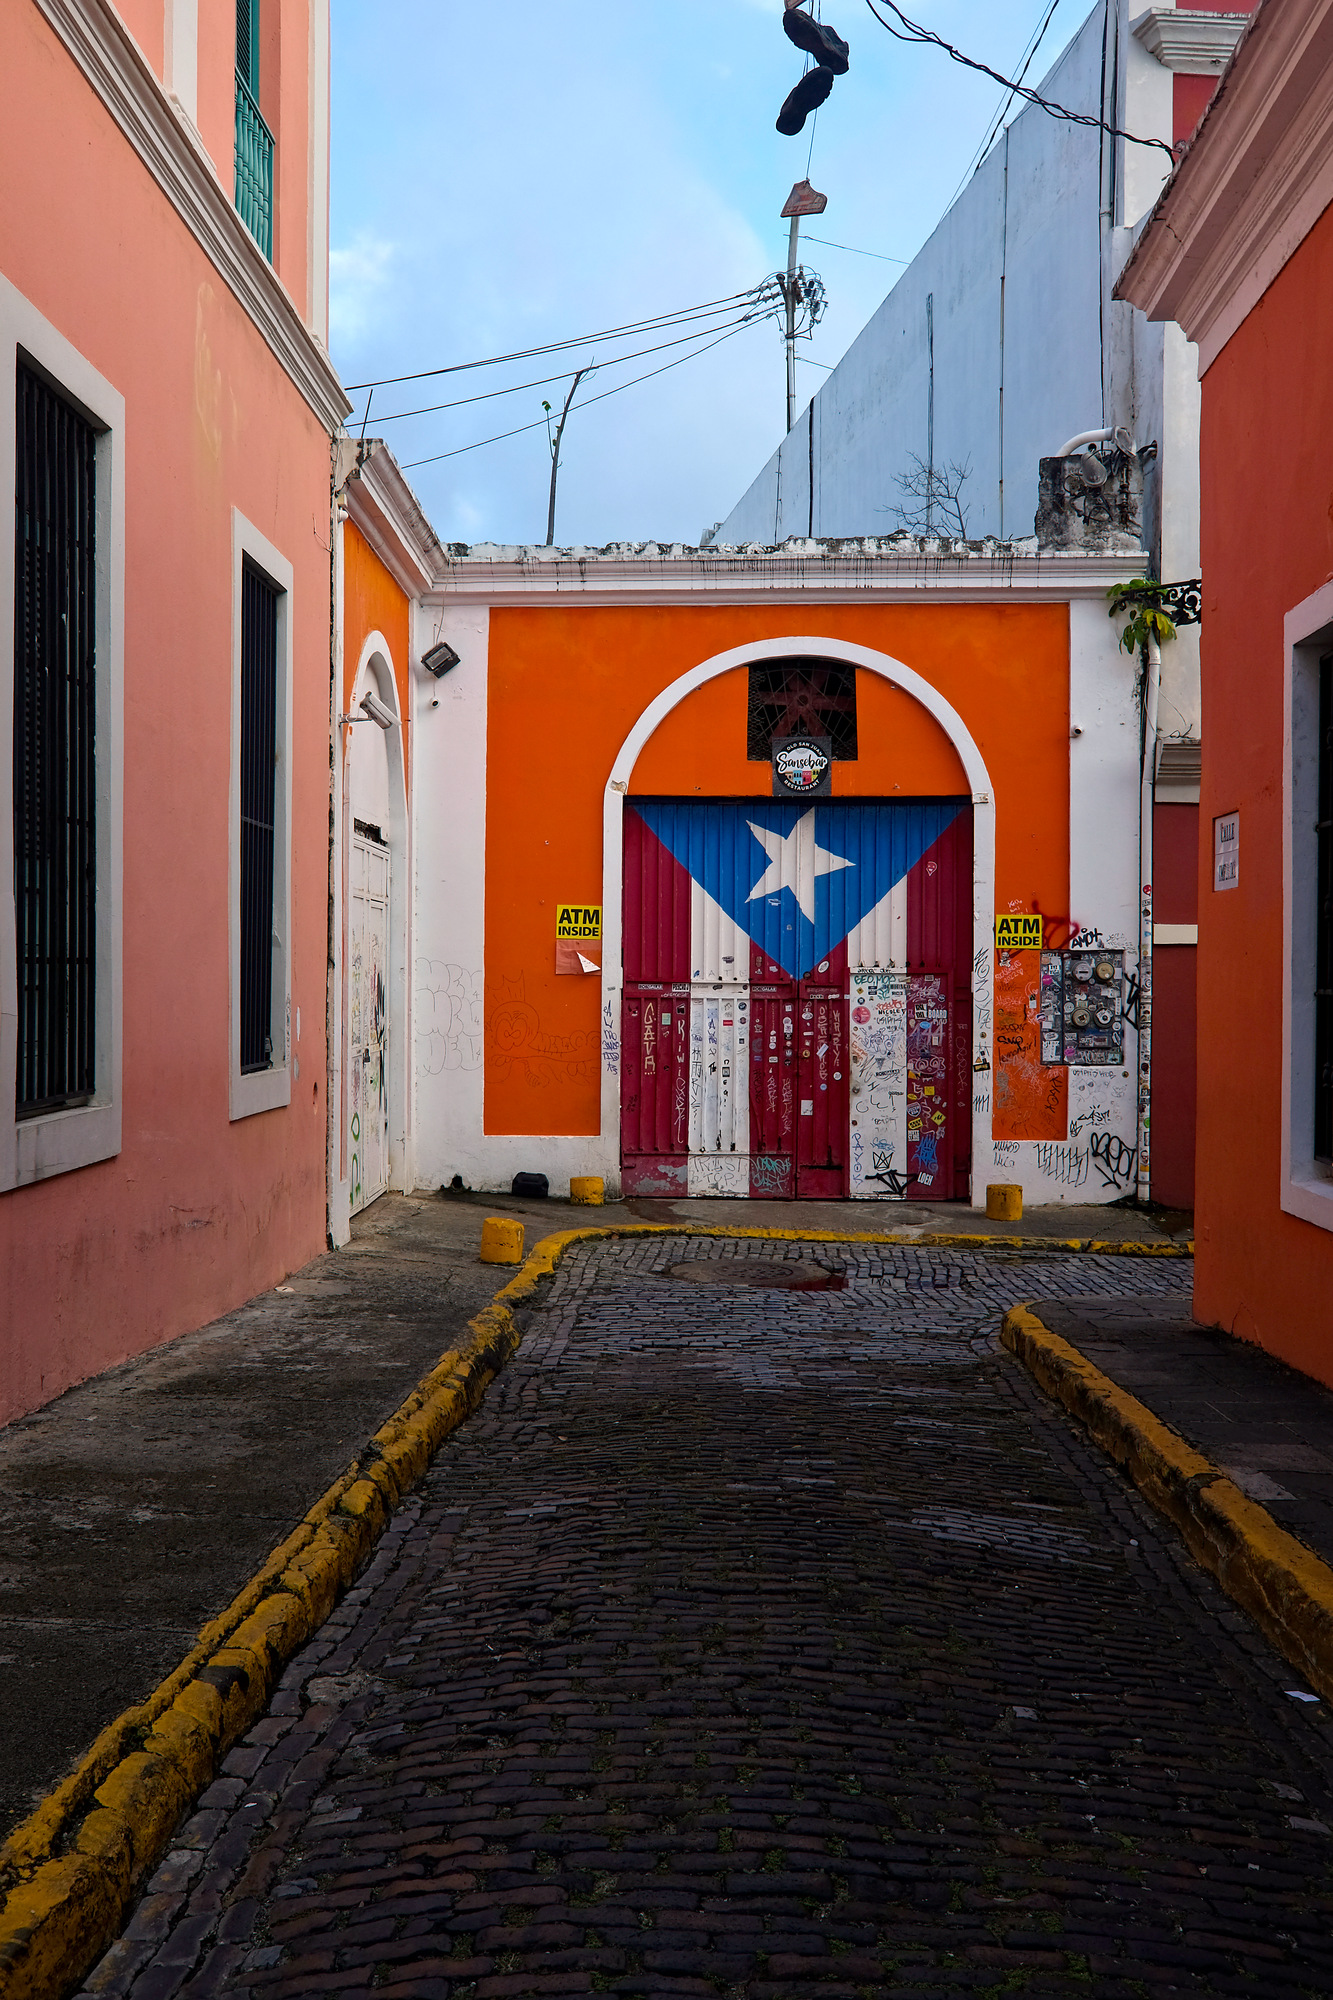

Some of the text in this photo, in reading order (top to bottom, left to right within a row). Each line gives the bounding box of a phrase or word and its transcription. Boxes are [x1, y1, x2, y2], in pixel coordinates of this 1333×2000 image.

[810, 743, 823, 756] JUAN
[778, 753, 827, 772] Sansebar
[783, 779, 820, 791] RESTAURANT
[558, 908, 600, 925] ATM
[557, 926, 599, 937] INSIDE
[998, 918, 1040, 934] ATM
[997, 936, 1040, 946] INSIDE
